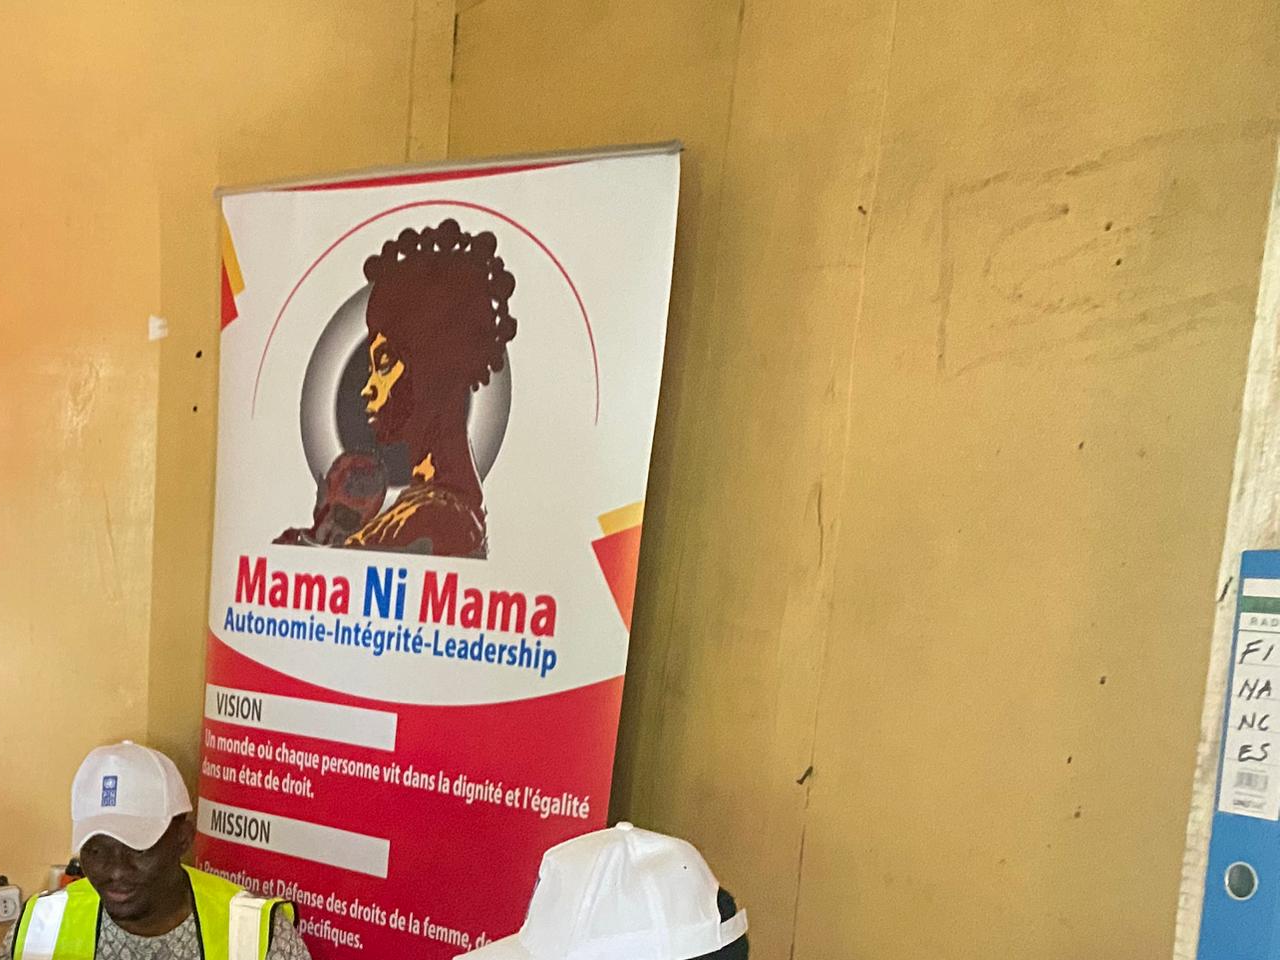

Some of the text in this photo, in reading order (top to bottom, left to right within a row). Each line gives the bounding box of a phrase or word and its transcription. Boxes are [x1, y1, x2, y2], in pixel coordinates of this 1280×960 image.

[235, 555, 558, 638] Mama Ni Mama
[224, 607, 557, 677] Autonomie-Intégrité-Leadership
[217, 692, 262, 721] VISION
[202, 756, 314, 798] dans un état de droit.
[205, 728, 590, 819] Un monde où chaque personne vit dans la dignité et l'égalité
[211, 809, 270, 844] MISSION
[262, 880, 275, 896] et
[277, 880, 324, 911] Défense
[326, 892, 347, 915] des
[349, 897, 387, 926] droits
[389, 907, 406, 931] de
[408, 912, 420, 934] la
[423, 916, 472, 951] femme,
[297, 916, 364, 950] pécifiques.
